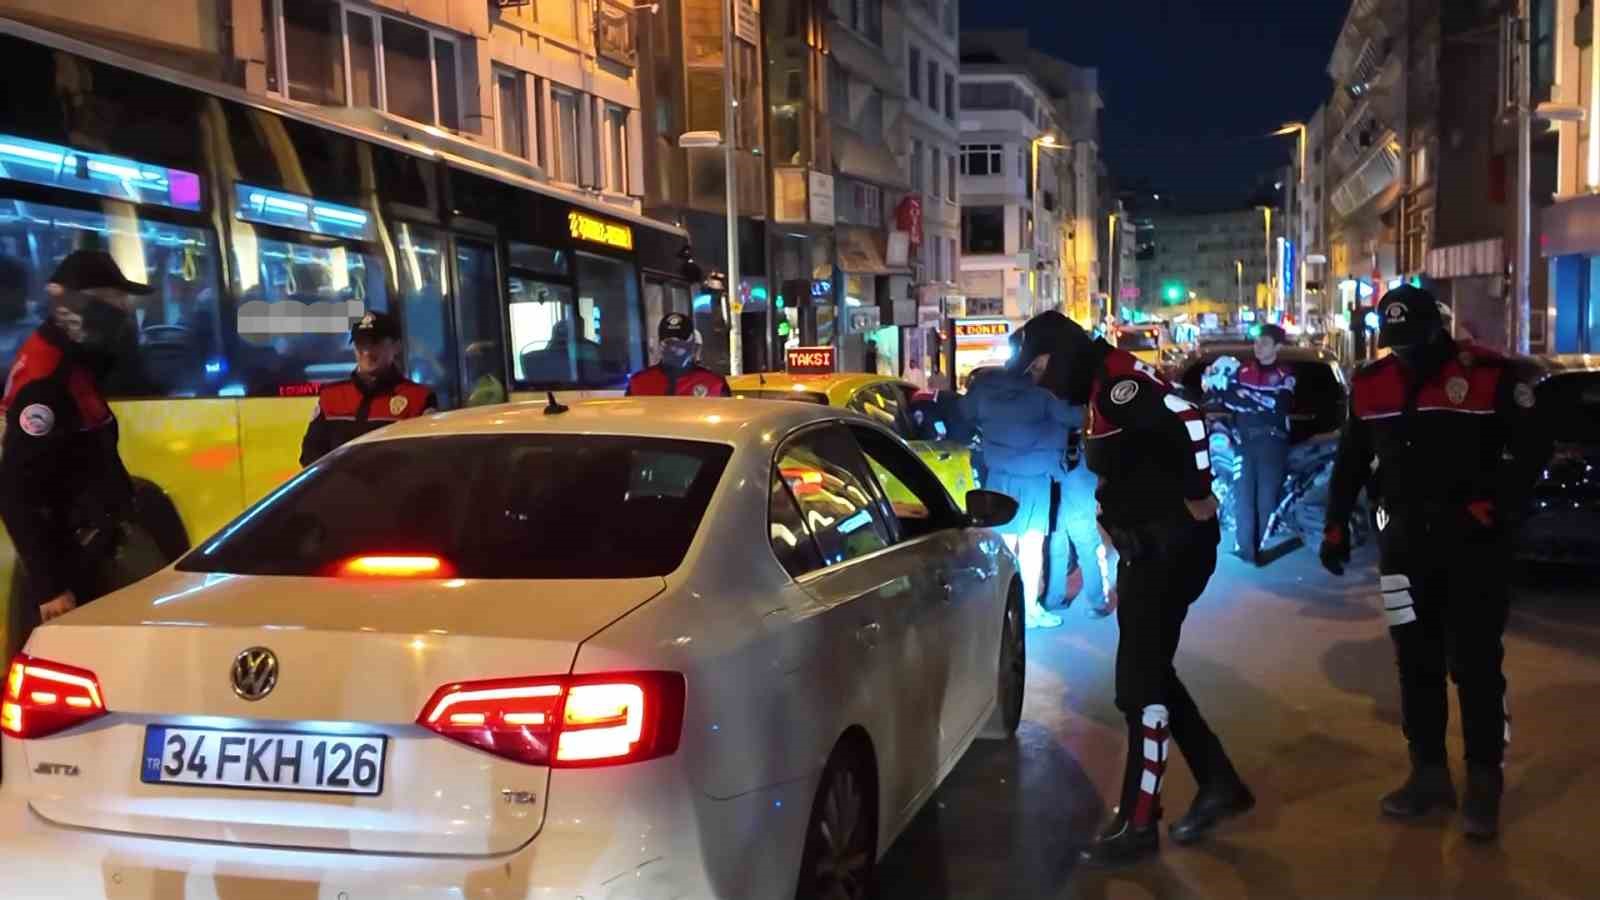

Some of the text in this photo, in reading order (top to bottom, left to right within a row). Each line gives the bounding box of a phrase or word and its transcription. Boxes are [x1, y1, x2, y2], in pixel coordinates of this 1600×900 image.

[789, 352, 830, 367] TAKSI
[146, 757, 161, 770] TR
[163, 734, 378, 788] 34 FKH 126
